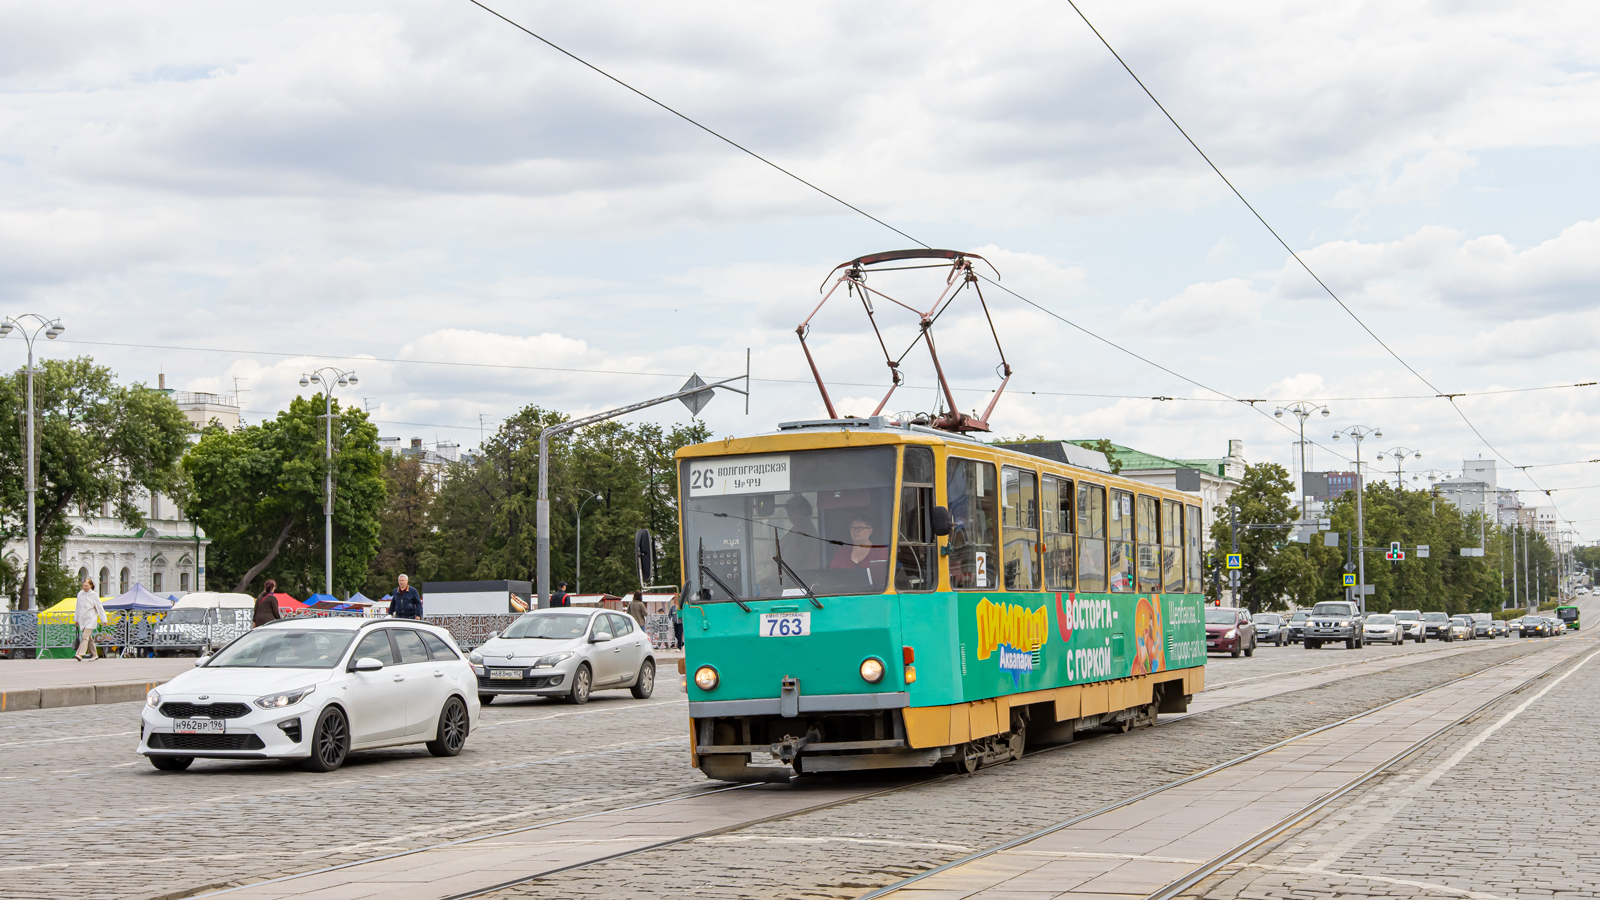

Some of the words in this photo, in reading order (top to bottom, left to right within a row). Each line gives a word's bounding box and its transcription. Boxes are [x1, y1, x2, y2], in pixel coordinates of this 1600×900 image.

[691, 468, 714, 489] 26
[976, 556, 986, 575] 2
[767, 618, 802, 636] 763
[976, 597, 1048, 660] ЛИМПОПО
[1067, 649, 1074, 681] С
[1075, 637, 1111, 680] ГОРКОЙ
[209, 720, 223, 728] 196
